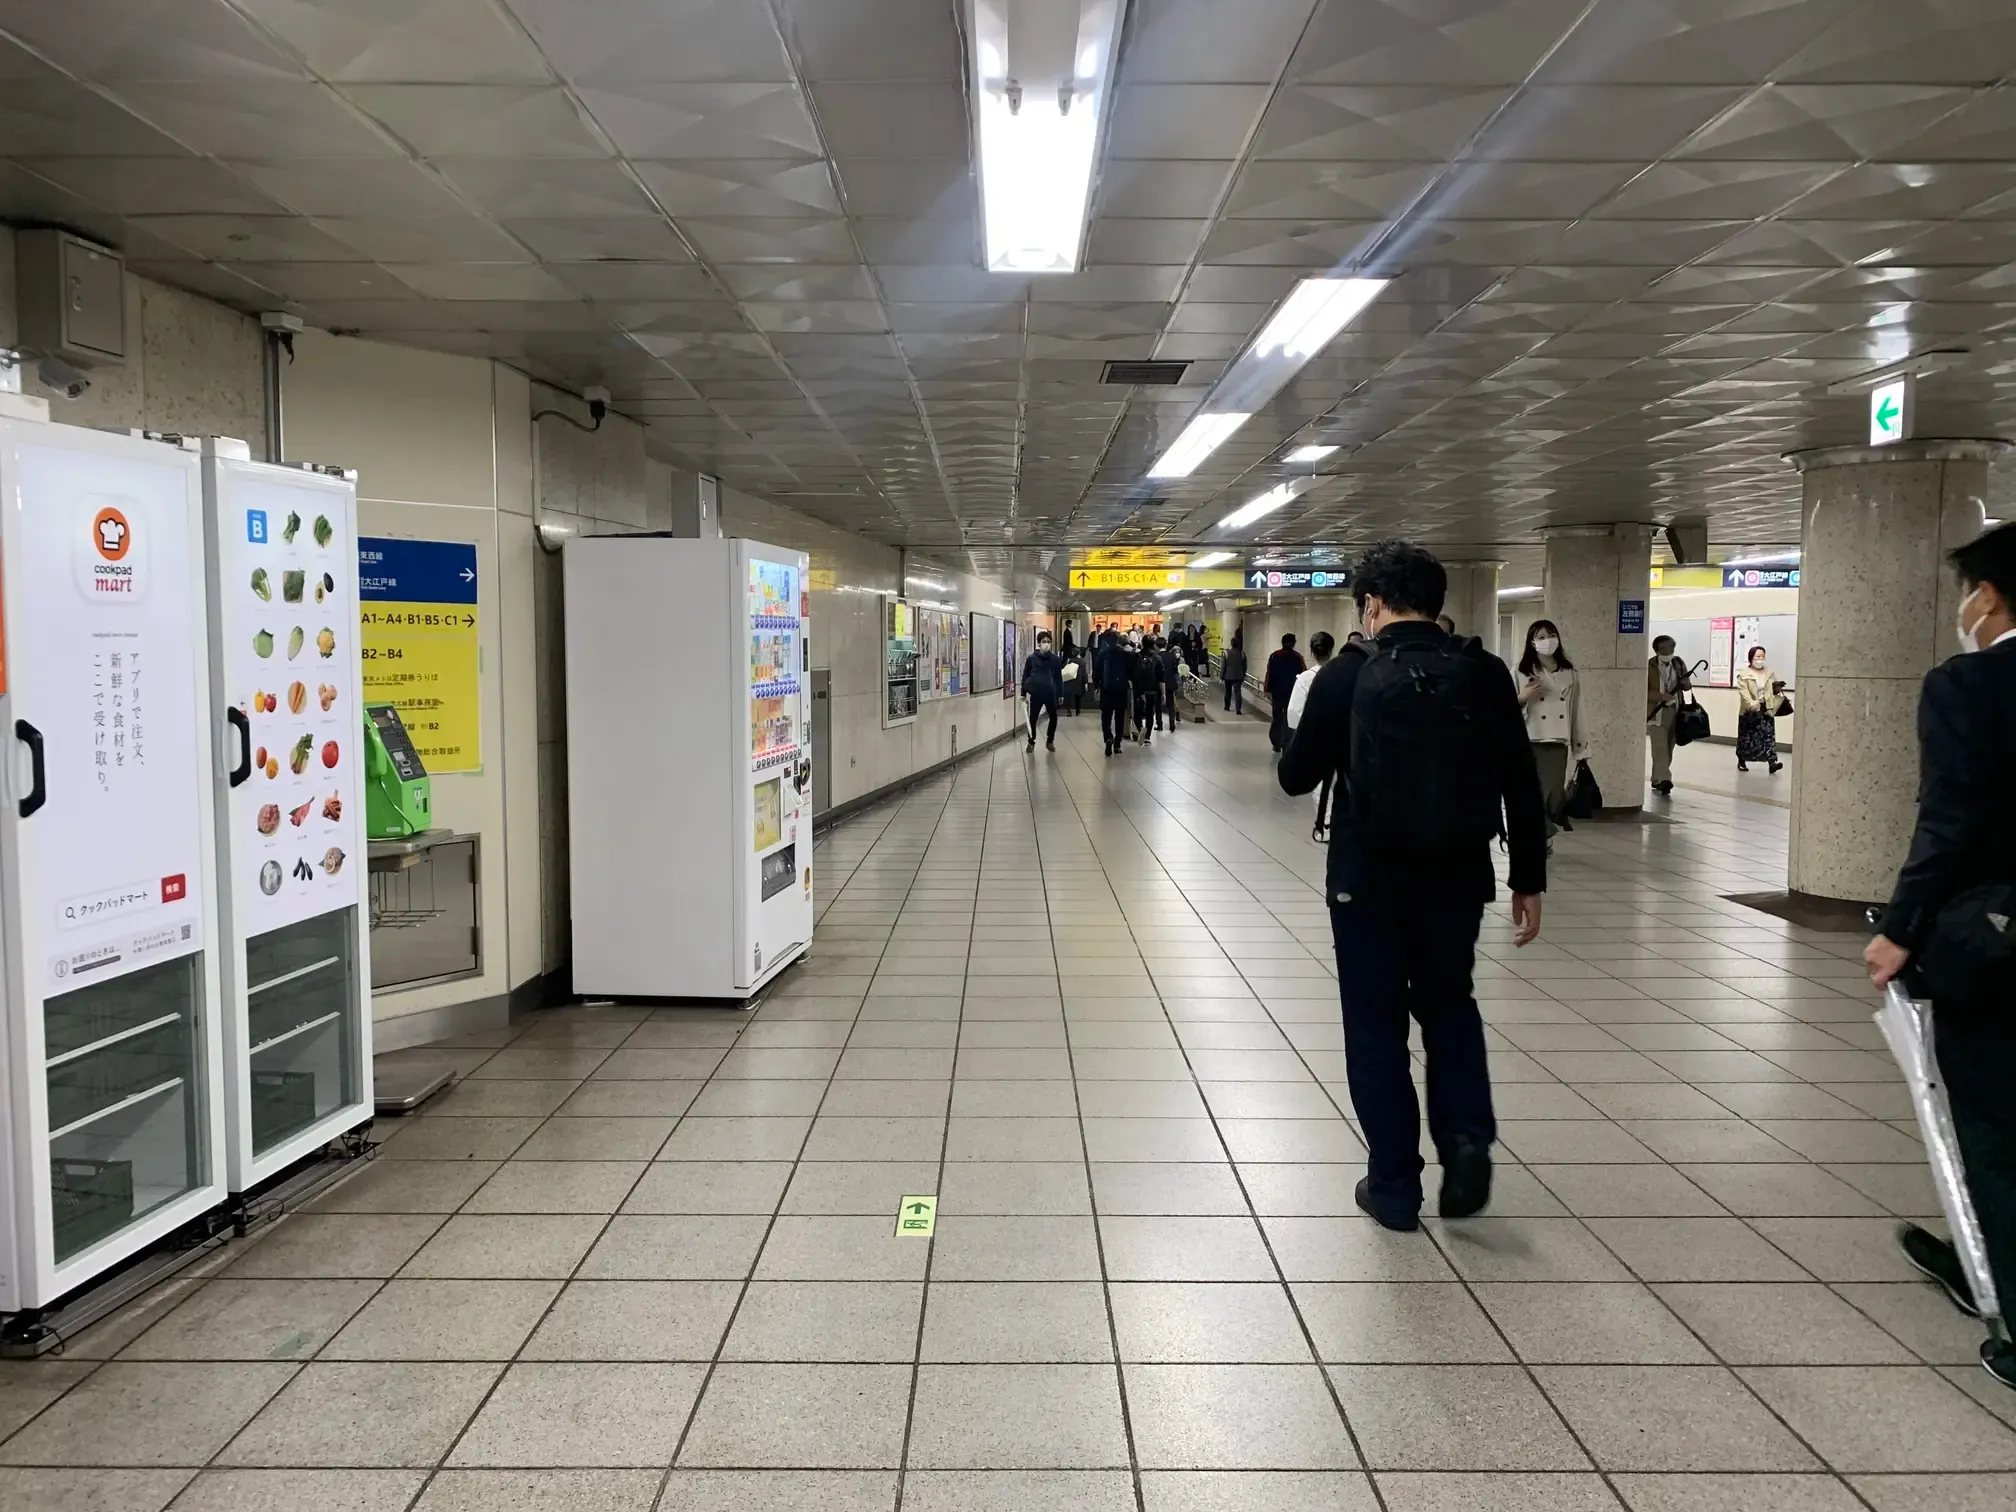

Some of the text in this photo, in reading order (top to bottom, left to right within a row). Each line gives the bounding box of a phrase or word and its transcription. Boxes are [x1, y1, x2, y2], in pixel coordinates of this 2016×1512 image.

[252, 520, 263, 538] B
[360, 551, 383, 561] 東西線
[94, 564, 132, 576] cookpad
[95, 577, 132, 592] mart
[364, 577, 397, 587] 大江戸線
[110, 652, 124, 767] 新鮮な食材を
[130, 652, 144, 766] アプリで注文、
[93, 653, 109, 792] ここで受け取り。
[80, 891, 148, 916] クックパッドマート
